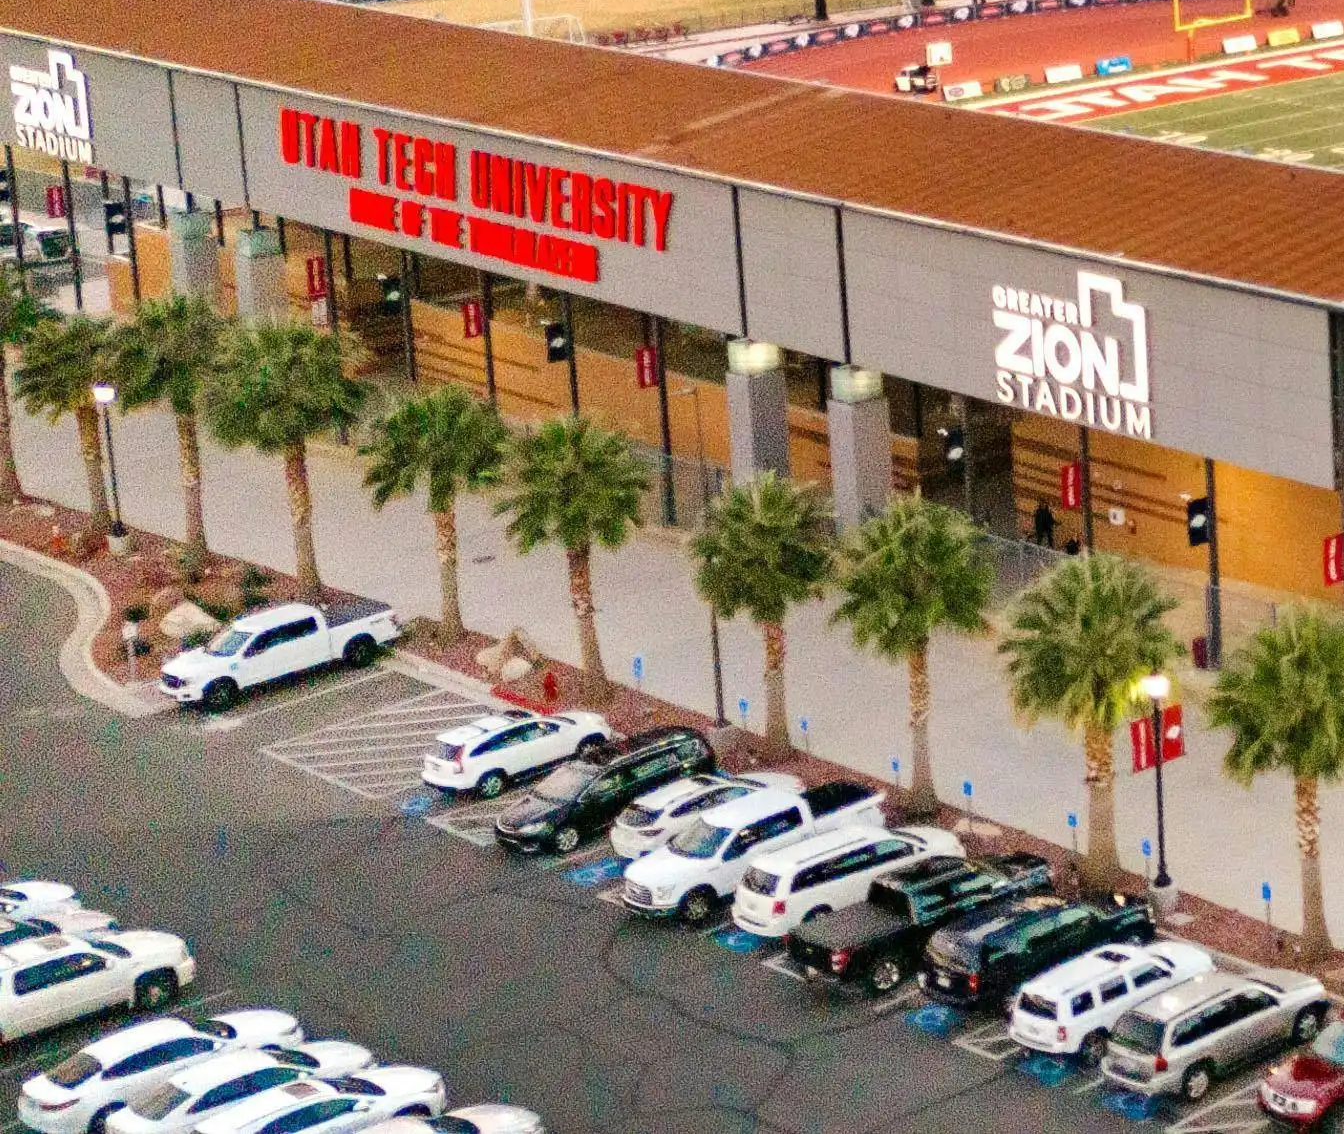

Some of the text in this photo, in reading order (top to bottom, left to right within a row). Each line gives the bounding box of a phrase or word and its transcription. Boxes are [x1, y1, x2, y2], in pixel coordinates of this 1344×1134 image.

[16, 123, 93, 165] STADIUM
[279, 106, 362, 180] UTAH
[373, 127, 458, 202] TECH
[470, 149, 673, 253] UNIVERSITY
[991, 284, 1080, 325] GREATER
[992, 309, 1120, 396] ZION
[995, 370, 1151, 440] STADIUM
